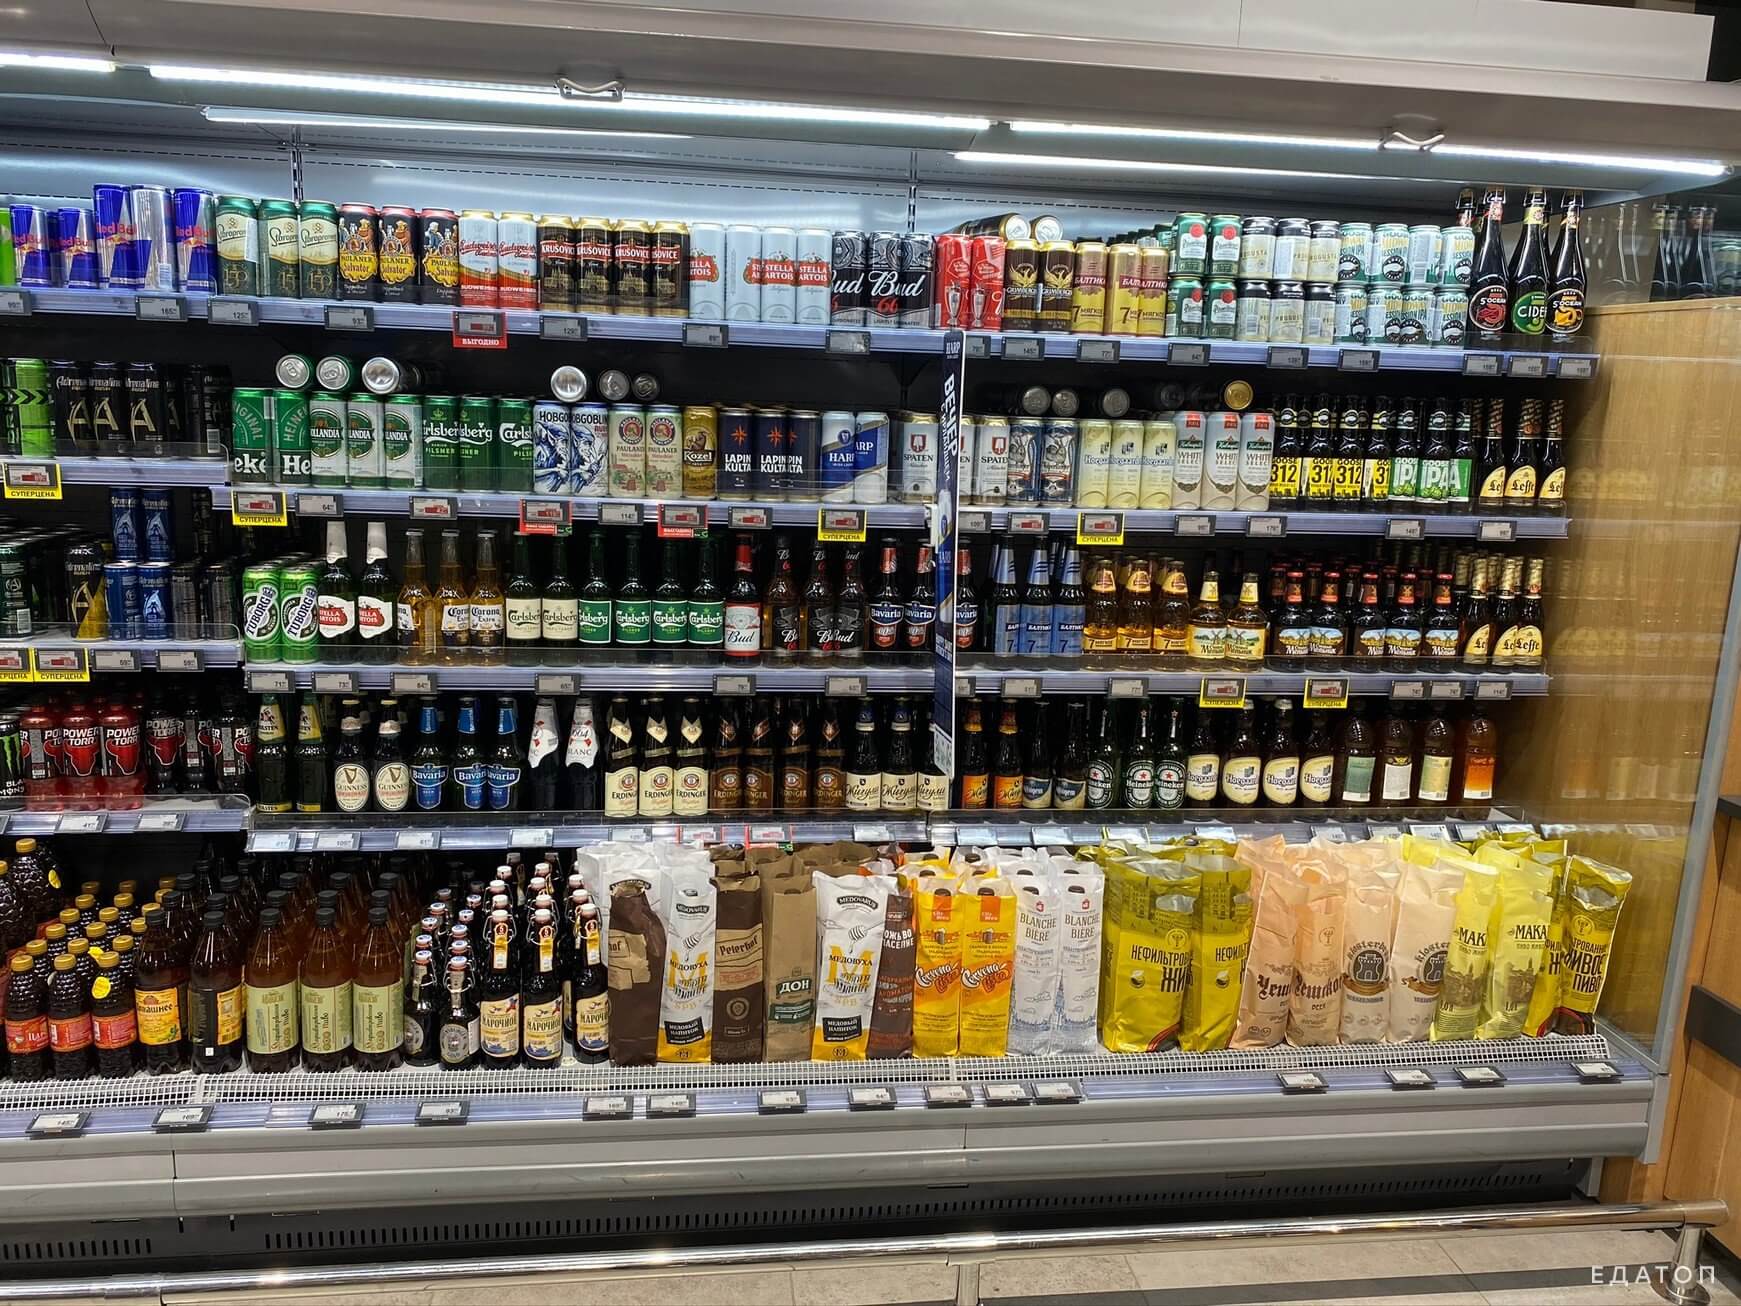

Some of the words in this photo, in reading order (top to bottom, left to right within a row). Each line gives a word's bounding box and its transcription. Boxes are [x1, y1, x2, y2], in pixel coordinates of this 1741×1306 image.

[766, 264, 793, 273] STELLA
[799, 265, 828, 273] STELLA
[765, 272, 795, 280] ARTOIS
[799, 273, 828, 281] ARTOIS
[1120, 307, 1131, 324] 7
[462, 337, 500, 347] ВЫГОДНО
[944, 373, 959, 458] ВЕЧЕР
[684, 452, 713, 462] Kozel
[904, 454, 934, 462] SPATEN
[1336, 466, 1362, 484] 312
[11, 490, 55, 498] СУПЕРЦЕНА
[239, 515, 282, 524] СУПЕРЦЕНА
[246, 594, 272, 637] TUBORG
[287, 595, 314, 639] TUBORG
[471, 607, 502, 617] Corona
[870, 608, 902, 619] Bavaria
[616, 611, 650, 625] Carlsberg
[653, 611, 687, 625] Carlsberg
[689, 612, 723, 626] Carlsberg
[727, 630, 756, 643] Bud
[1060, 640, 1069, 653] 7
[1089, 639, 1096, 649] 7
[1125, 638, 1132, 648] 7
[1164, 639, 1171, 649] 7
[1517, 638, 1540, 651] Leffe
[413, 769, 446, 780] Bavaria
[336, 783, 368, 791] GUINNESS
[1019, 912, 1057, 930] BLANCHE
[1064, 912, 1100, 927] BLANCHE
[902, 929, 913, 939] ВО
[720, 936, 758, 956] Peterhof
[829, 954, 873, 967] МЕДОВУХА
[780, 979, 810, 995] ДОН
